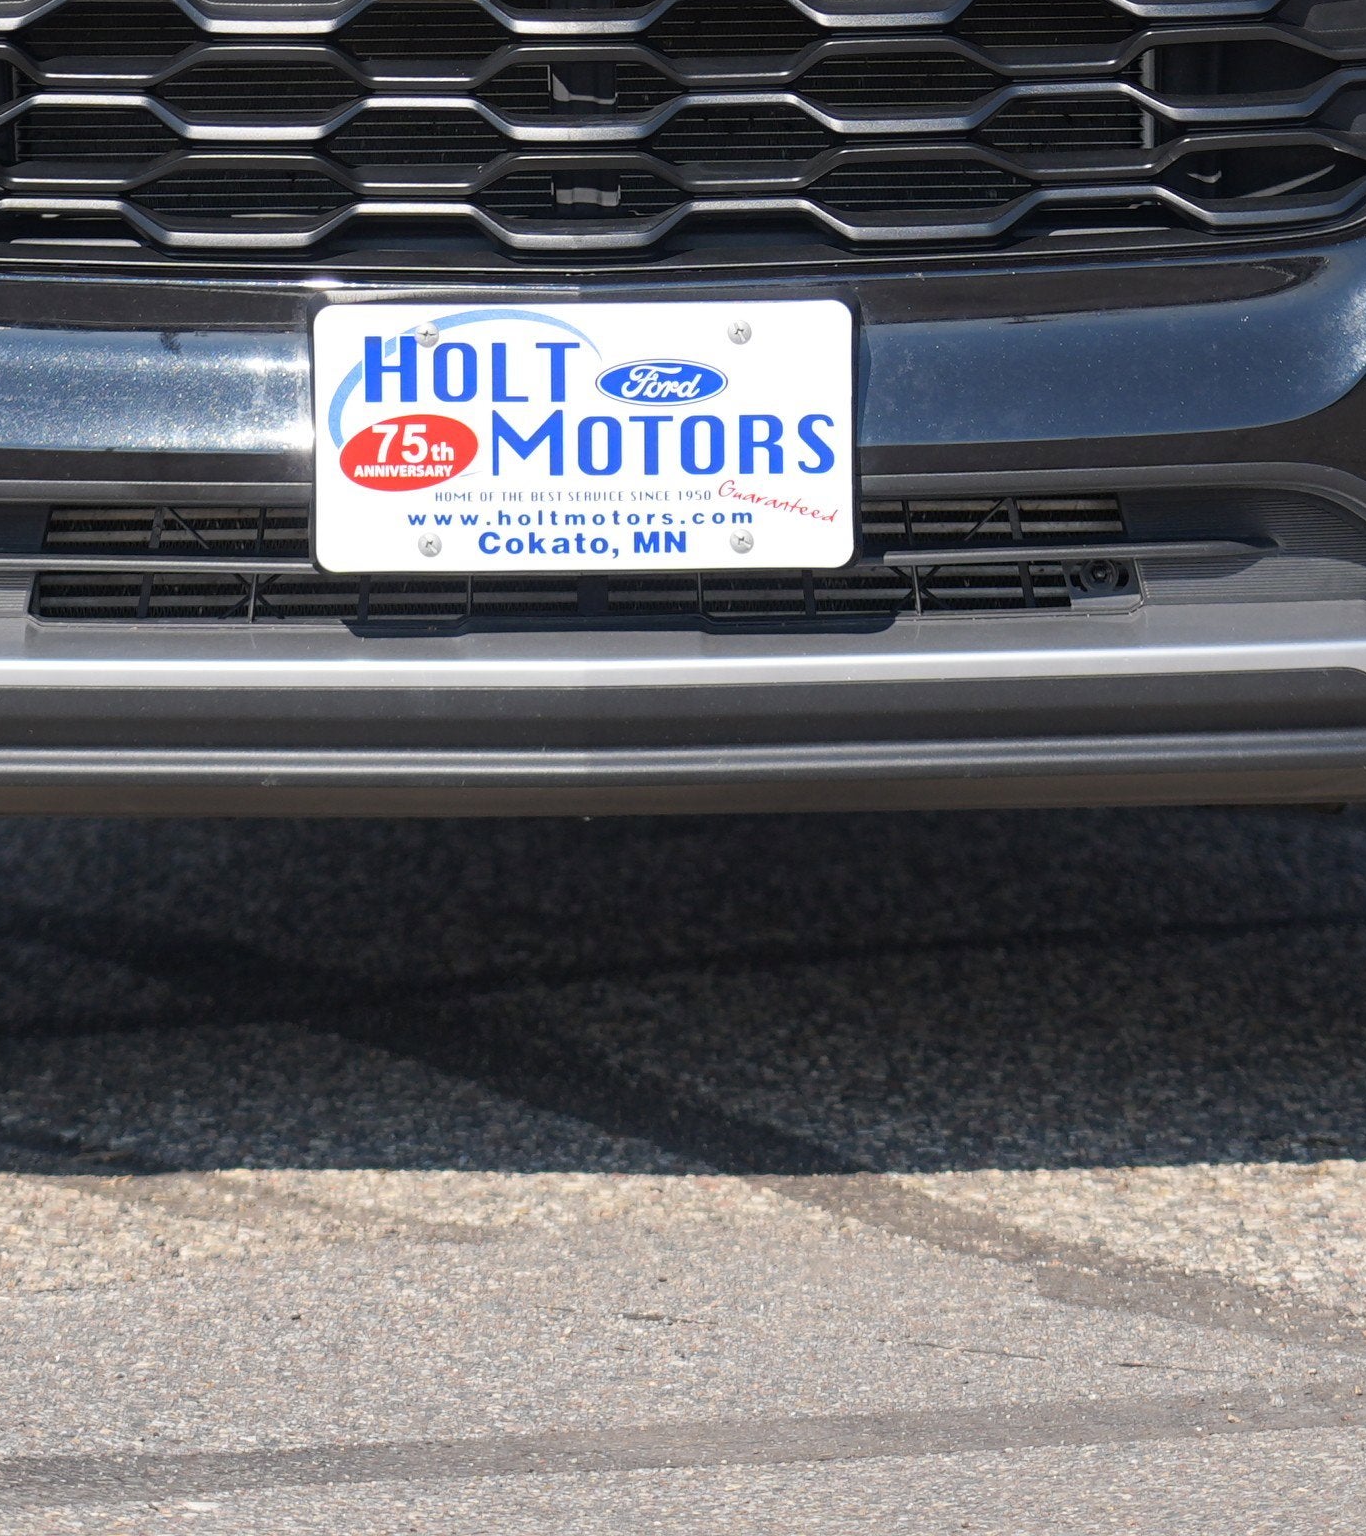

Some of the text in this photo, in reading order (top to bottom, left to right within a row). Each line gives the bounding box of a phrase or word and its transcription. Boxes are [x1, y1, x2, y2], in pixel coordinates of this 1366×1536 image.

[363, 335, 580, 403] HOLT
[620, 364, 703, 399] Ford
[371, 423, 455, 464] 75th
[492, 409, 835, 476] MOTORS
[353, 464, 454, 478] ANNIVERSARY
[435, 490, 712, 502] HOME OF THE BEST SERVICE SINCE 1950
[717, 479, 839, 523] Guaranteed
[406, 509, 754, 526] www.holtmotors.com
[478, 531, 687, 559] Cokato, MN
